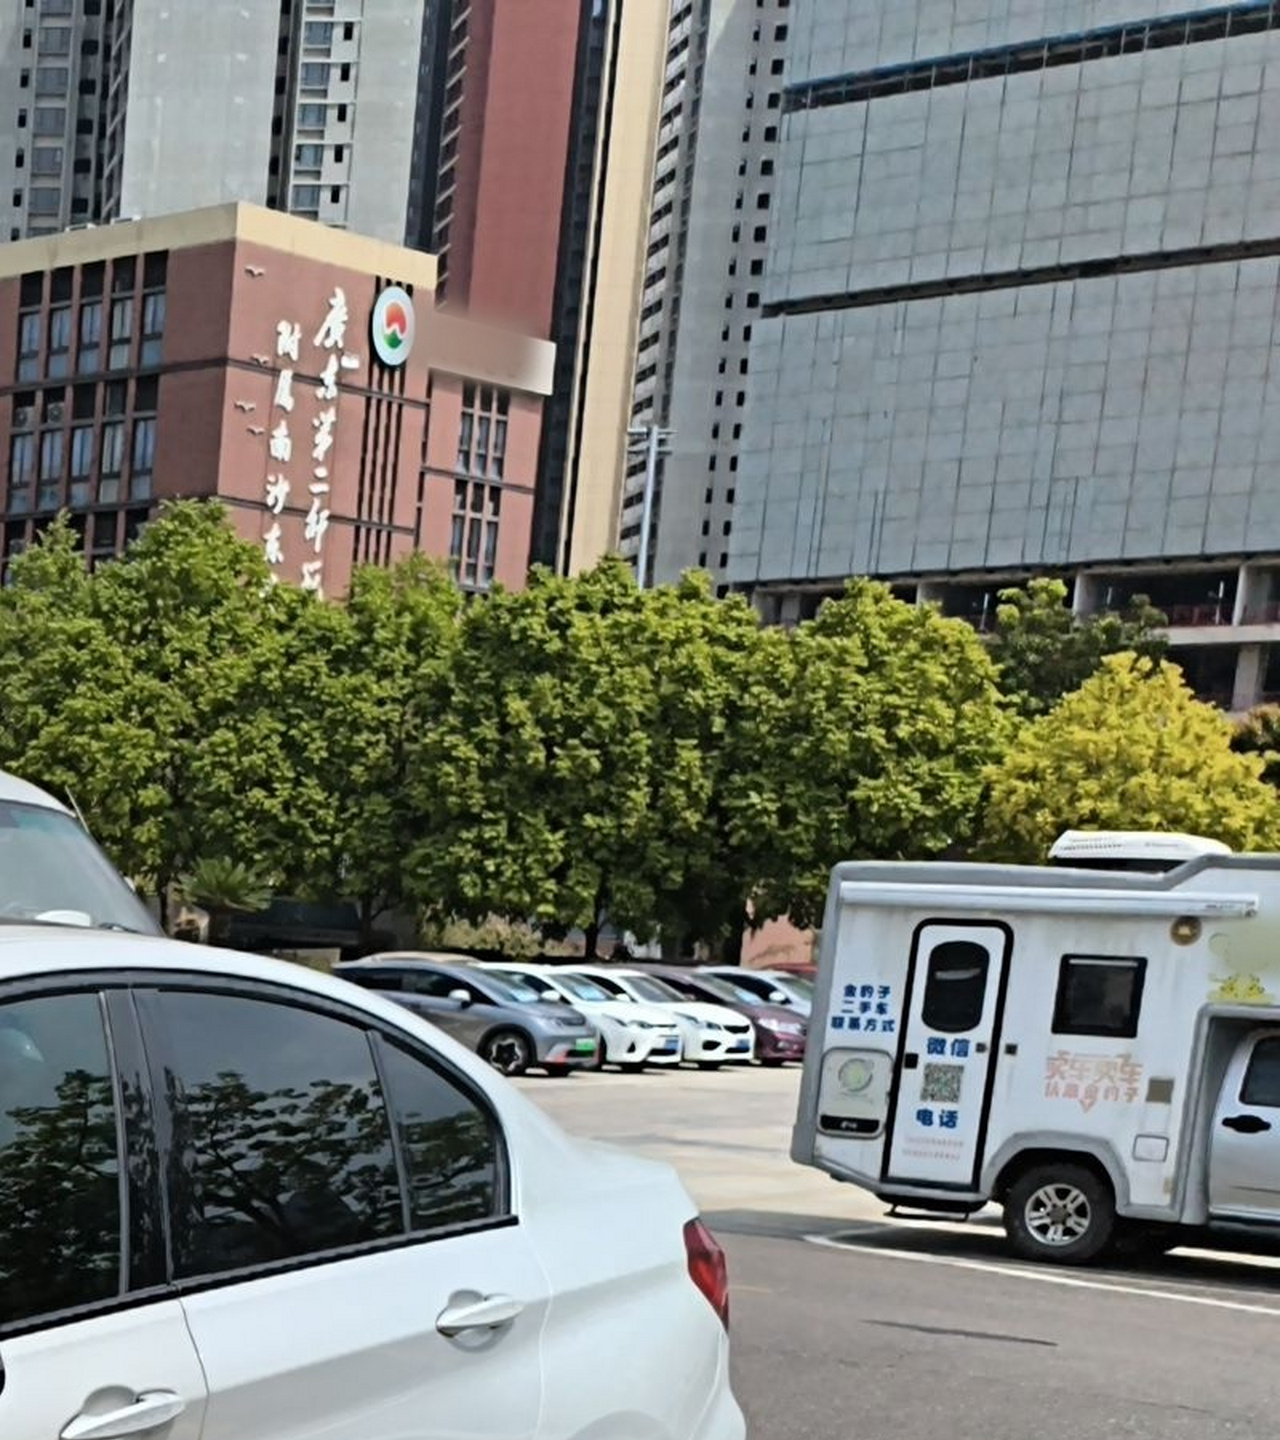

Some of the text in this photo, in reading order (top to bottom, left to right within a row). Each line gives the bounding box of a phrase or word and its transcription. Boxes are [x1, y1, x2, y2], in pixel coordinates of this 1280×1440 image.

[841, 1000, 889, 1015] 二手车
[831, 1016, 895, 1032] 联系方式
[926, 1036, 971, 1057] 微信
[915, 1108, 959, 1128] 电话
